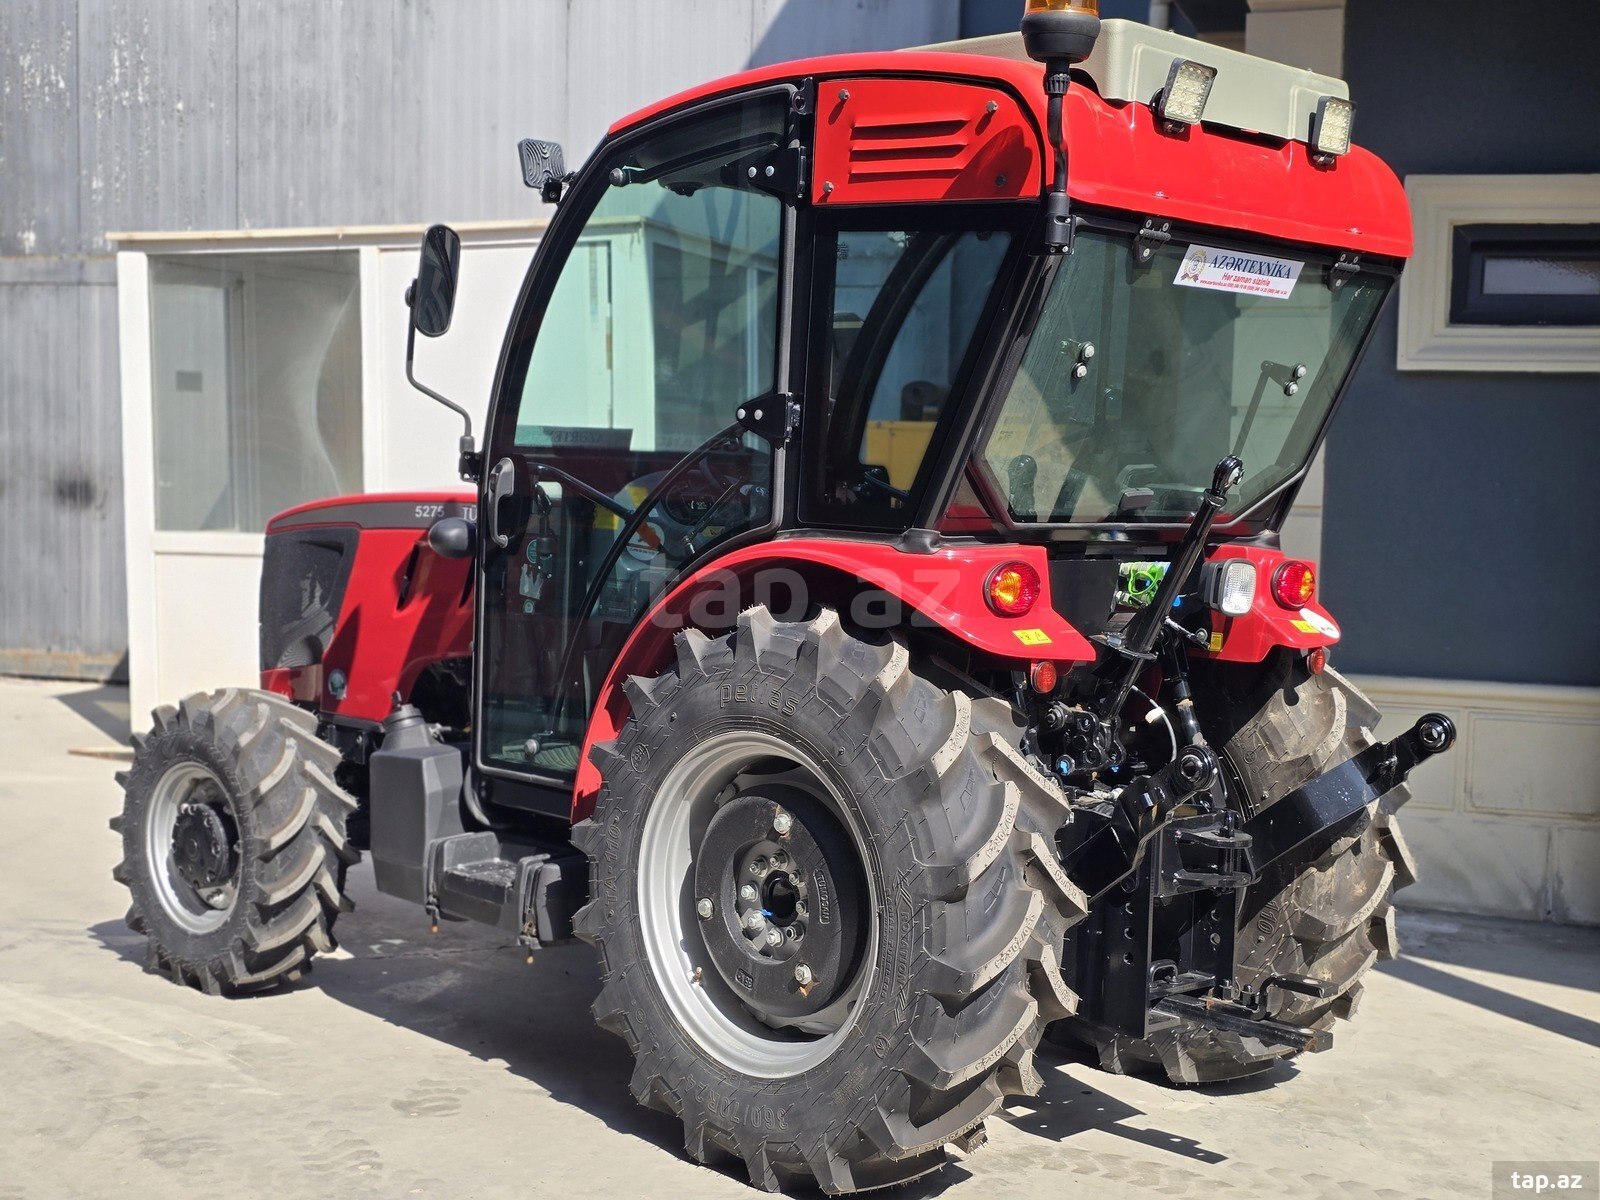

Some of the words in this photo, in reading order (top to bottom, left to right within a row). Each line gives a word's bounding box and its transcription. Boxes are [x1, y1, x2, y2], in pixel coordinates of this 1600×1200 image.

[1209, 254, 1292, 279] AZƏRTEXNİKA
[1233, 274, 1253, 284] zaman
[415, 505, 445, 518] 5275
[897, 911, 910, 986] ROTATION
